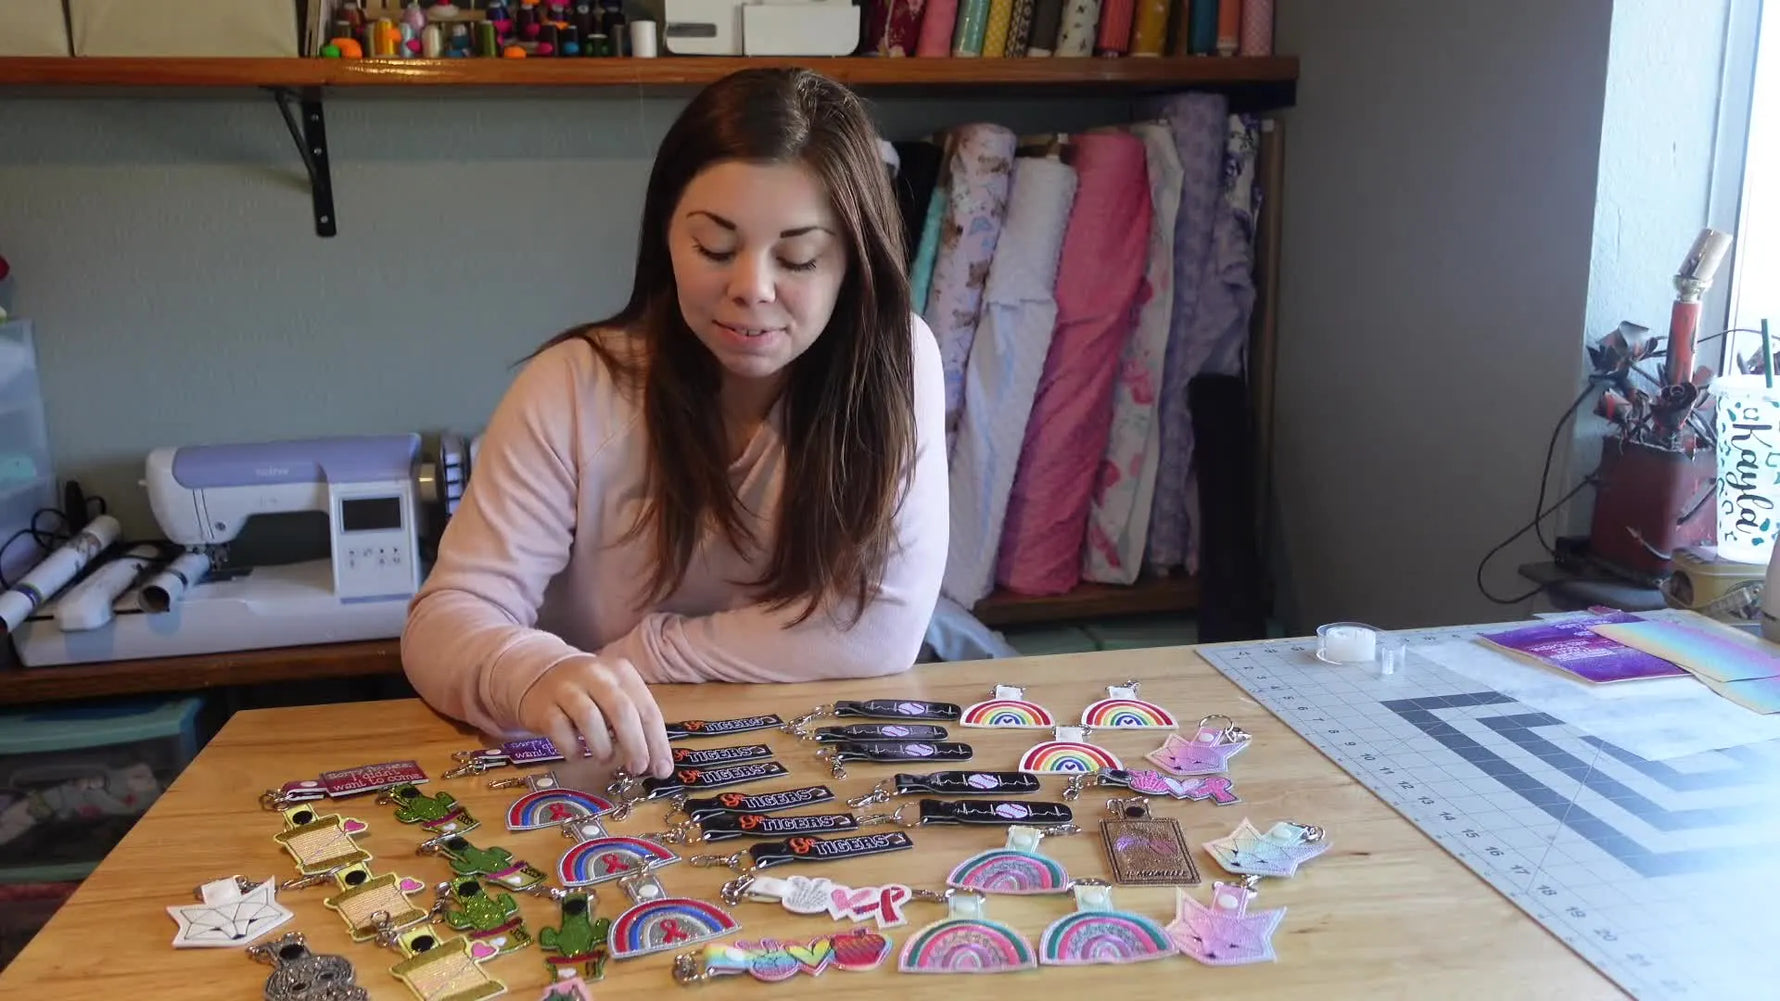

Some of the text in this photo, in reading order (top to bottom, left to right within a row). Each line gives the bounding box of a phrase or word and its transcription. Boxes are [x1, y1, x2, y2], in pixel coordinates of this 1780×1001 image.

[705, 718, 765, 732] TIGERS
[688, 745, 753, 763] TIGERS
[1360, 753, 1376, 761] 10
[700, 763, 766, 783] TIGERS
[1379, 766, 1395, 775] 11
[333, 780, 366, 791] want
[370, 776, 384, 785] to
[1398, 780, 1414, 790] 12
[743, 789, 812, 808] TIGERS
[1418, 795, 1435, 805] 13
[1439, 811, 1456, 821] 14
[760, 814, 835, 831] TIGERS
[1461, 828, 1480, 839] 15
[814, 834, 889, 855] TIGERS
[1485, 846, 1504, 857] 16
[1510, 864, 1531, 876] 17
[1536, 884, 1557, 896] 18
[1565, 906, 1587, 919] 19
